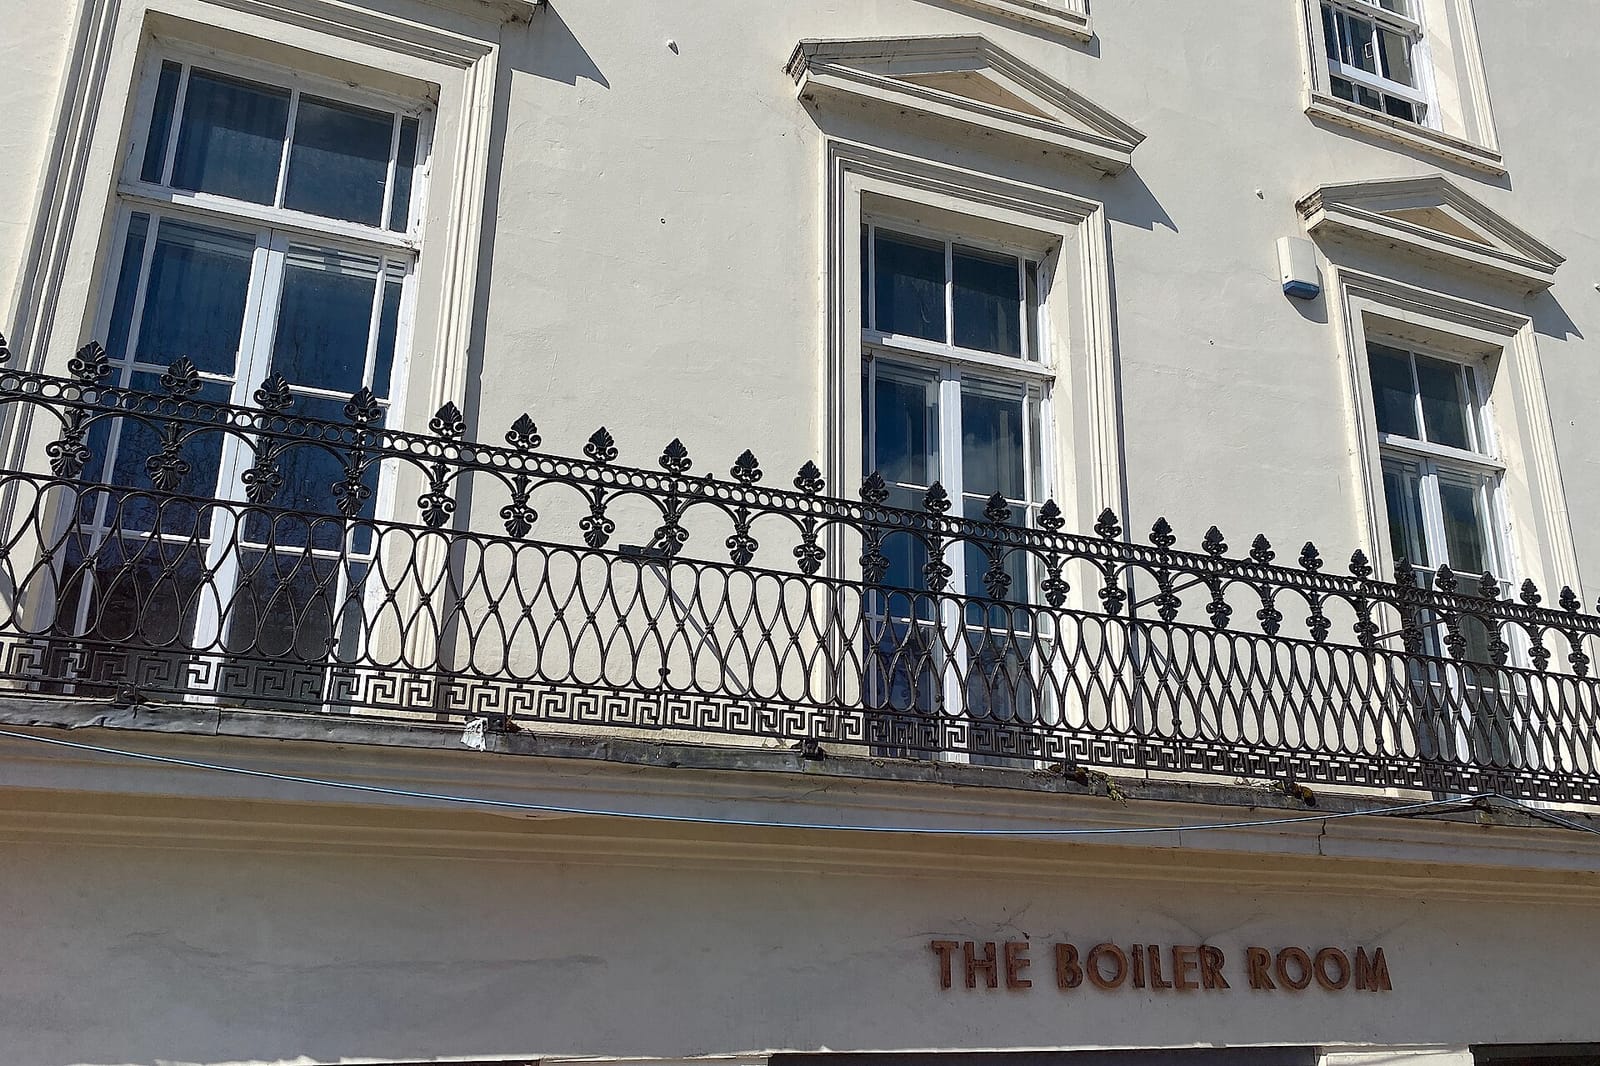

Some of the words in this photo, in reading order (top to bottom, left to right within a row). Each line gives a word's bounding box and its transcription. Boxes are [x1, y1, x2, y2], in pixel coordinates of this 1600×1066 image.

[931, 940, 1033, 990] THE
[1056, 942, 1231, 990] BOILER
[1246, 945, 1393, 992] ROOM
